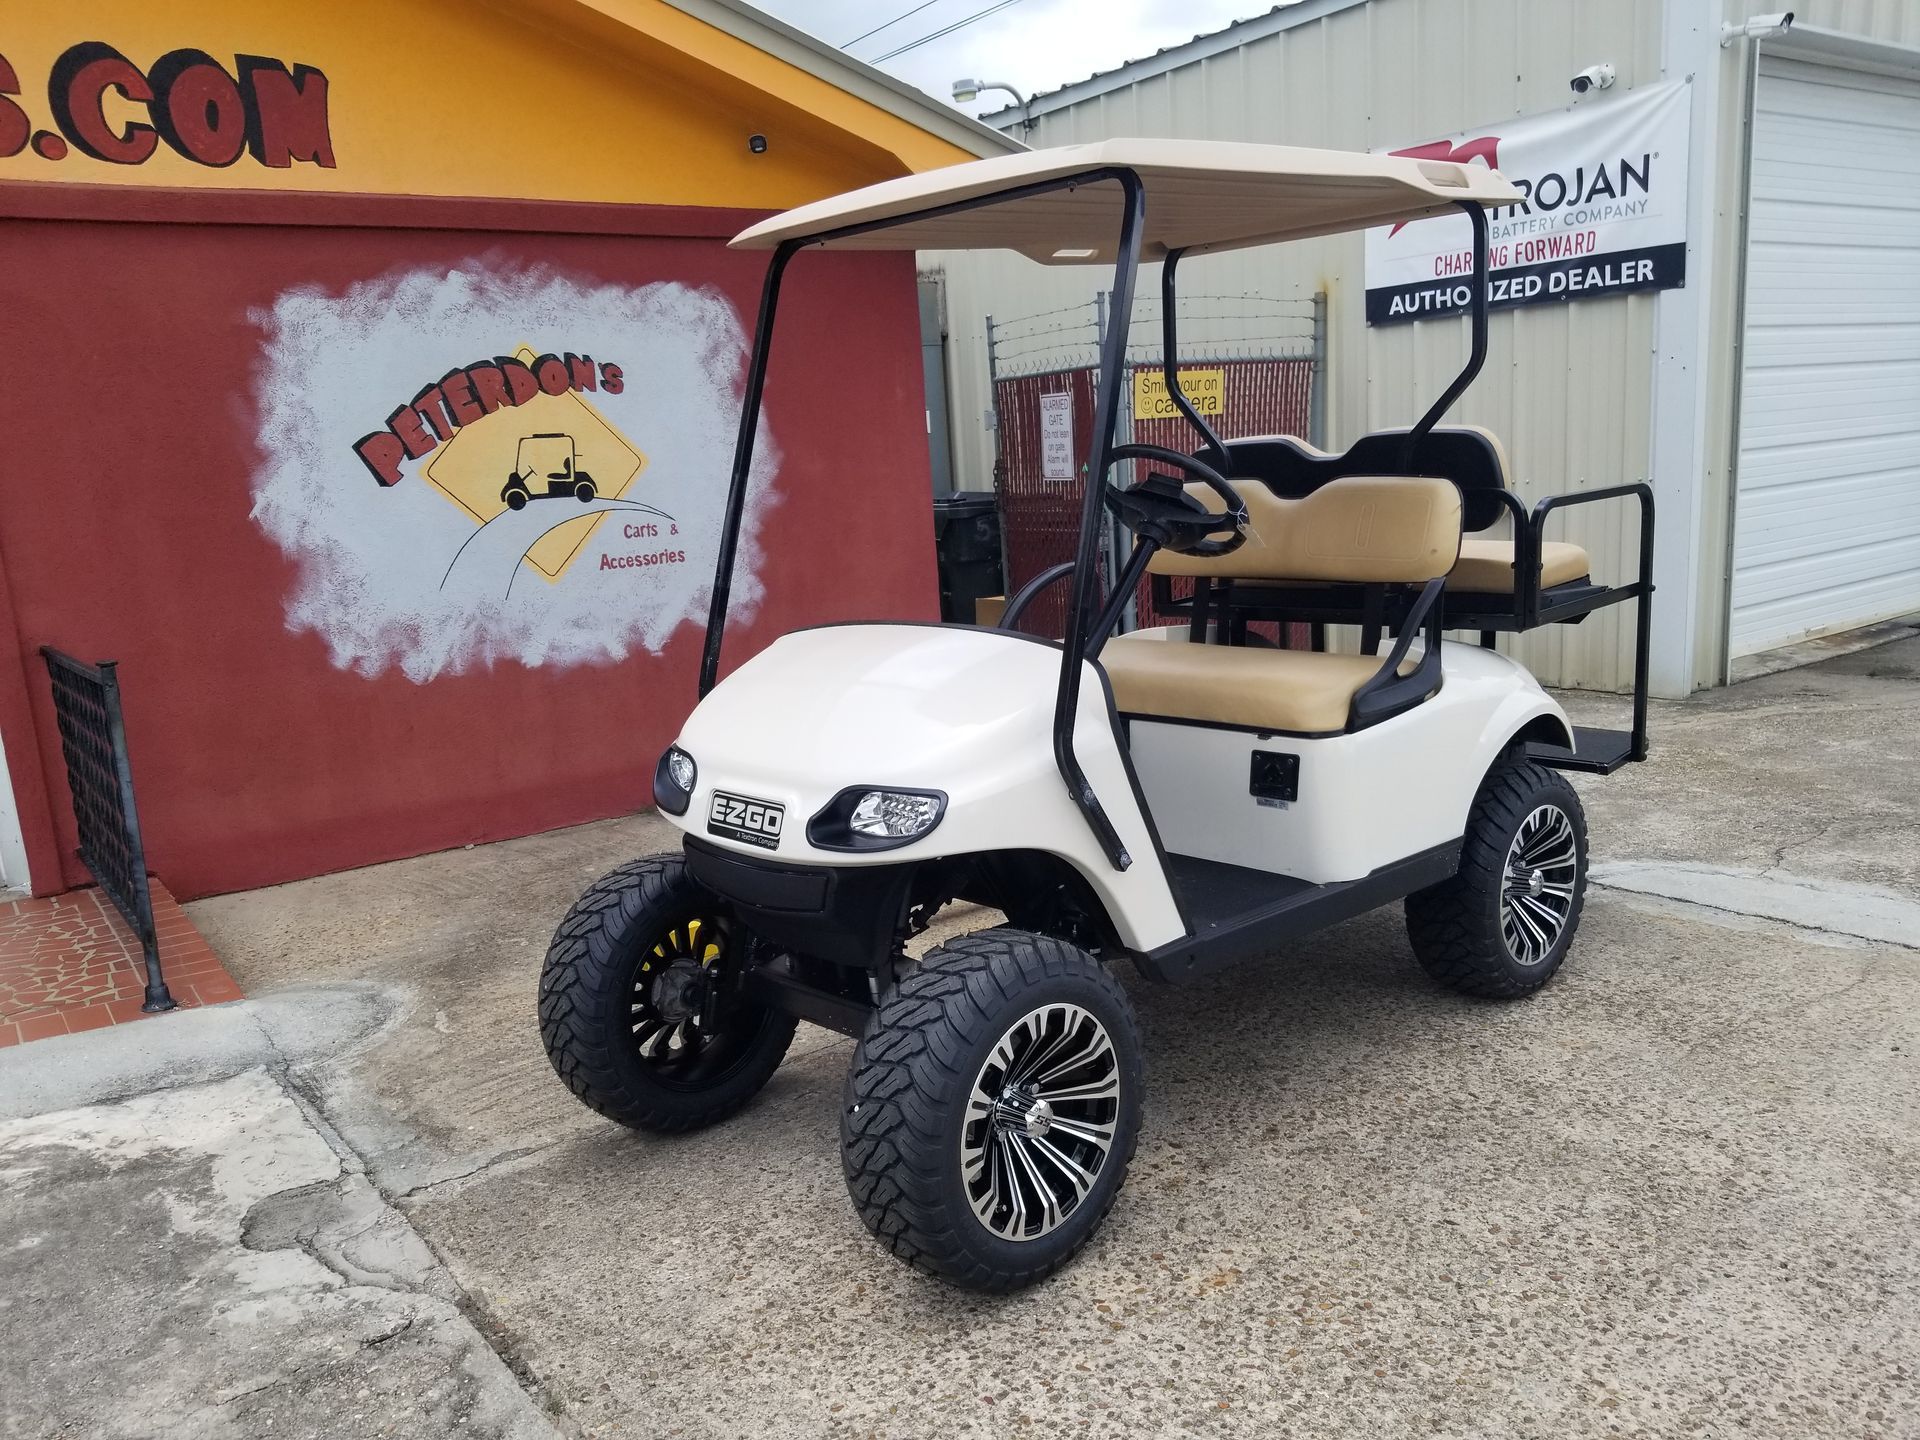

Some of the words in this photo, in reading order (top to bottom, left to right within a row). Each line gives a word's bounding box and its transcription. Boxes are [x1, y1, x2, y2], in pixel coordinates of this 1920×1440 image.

[1493, 153, 1650, 220] ROJAN
[1492, 215, 1557, 240] BATTERY
[1564, 199, 1649, 226] COMPANY
[1434, 245, 1507, 276] CHARNG
[1515, 231, 1596, 264] FORWARD
[1388, 277, 1541, 315] AUTHOIZED
[1549, 260, 1654, 293] DEALER
[1204, 378, 1217, 391] on
[1154, 395, 1217, 414] caera
[1048, 414, 1064, 426] GATE
[624, 521, 658, 539] Carts
[669, 523, 679, 536] &
[600, 549, 686, 571] Accessories
[741, 833, 758, 843] Textron
[758, 837, 779, 849] Company
